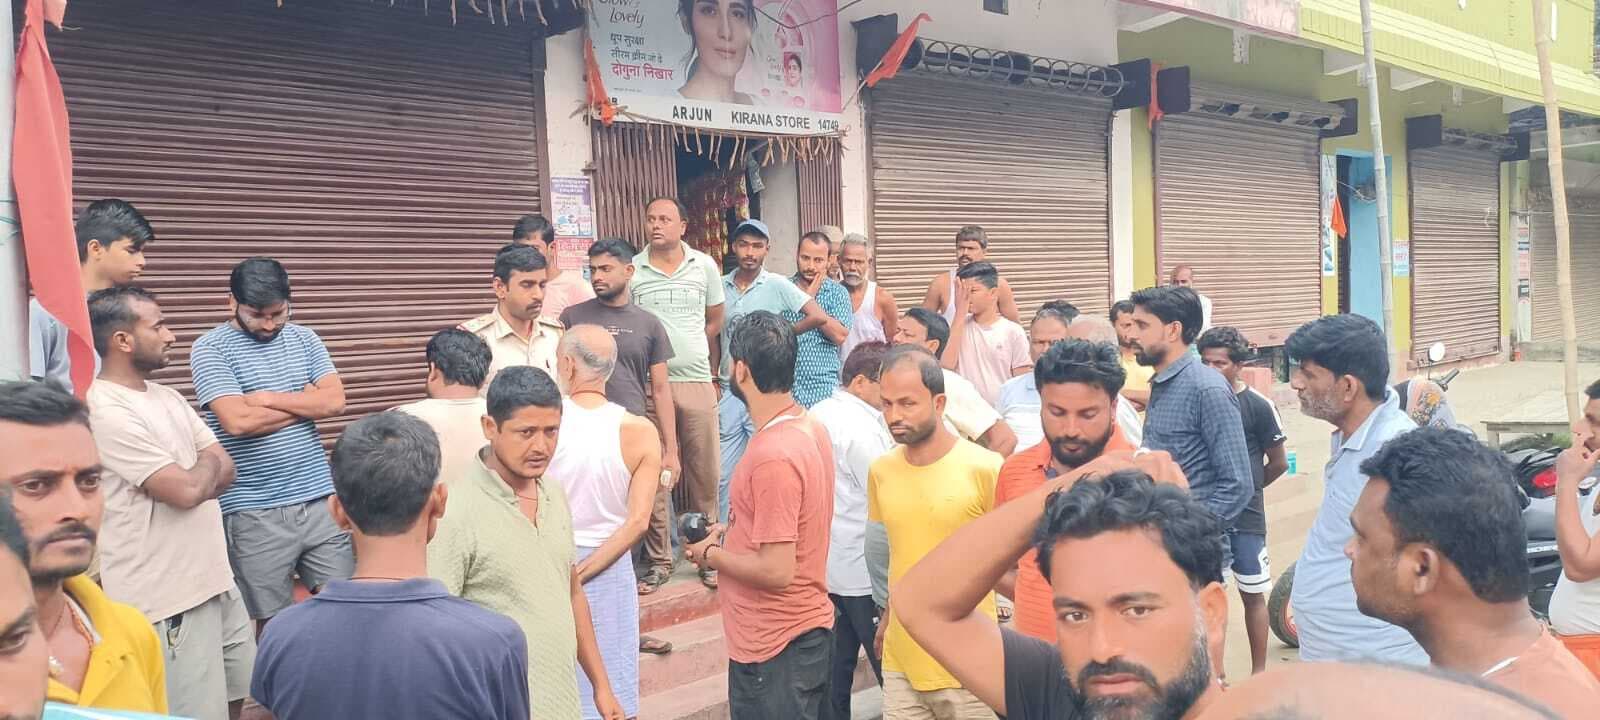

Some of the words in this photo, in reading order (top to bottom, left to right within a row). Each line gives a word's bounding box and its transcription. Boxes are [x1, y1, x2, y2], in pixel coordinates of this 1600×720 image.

[609, 7, 645, 28] Lovely
[610, 60, 640, 80] दोगुना
[643, 63, 673, 80] निखार
[672, 105, 712, 121] ARJUN
[731, 111, 773, 127] KIRANA
[775, 114, 810, 129] STORE
[817, 119, 839, 131] 14749
